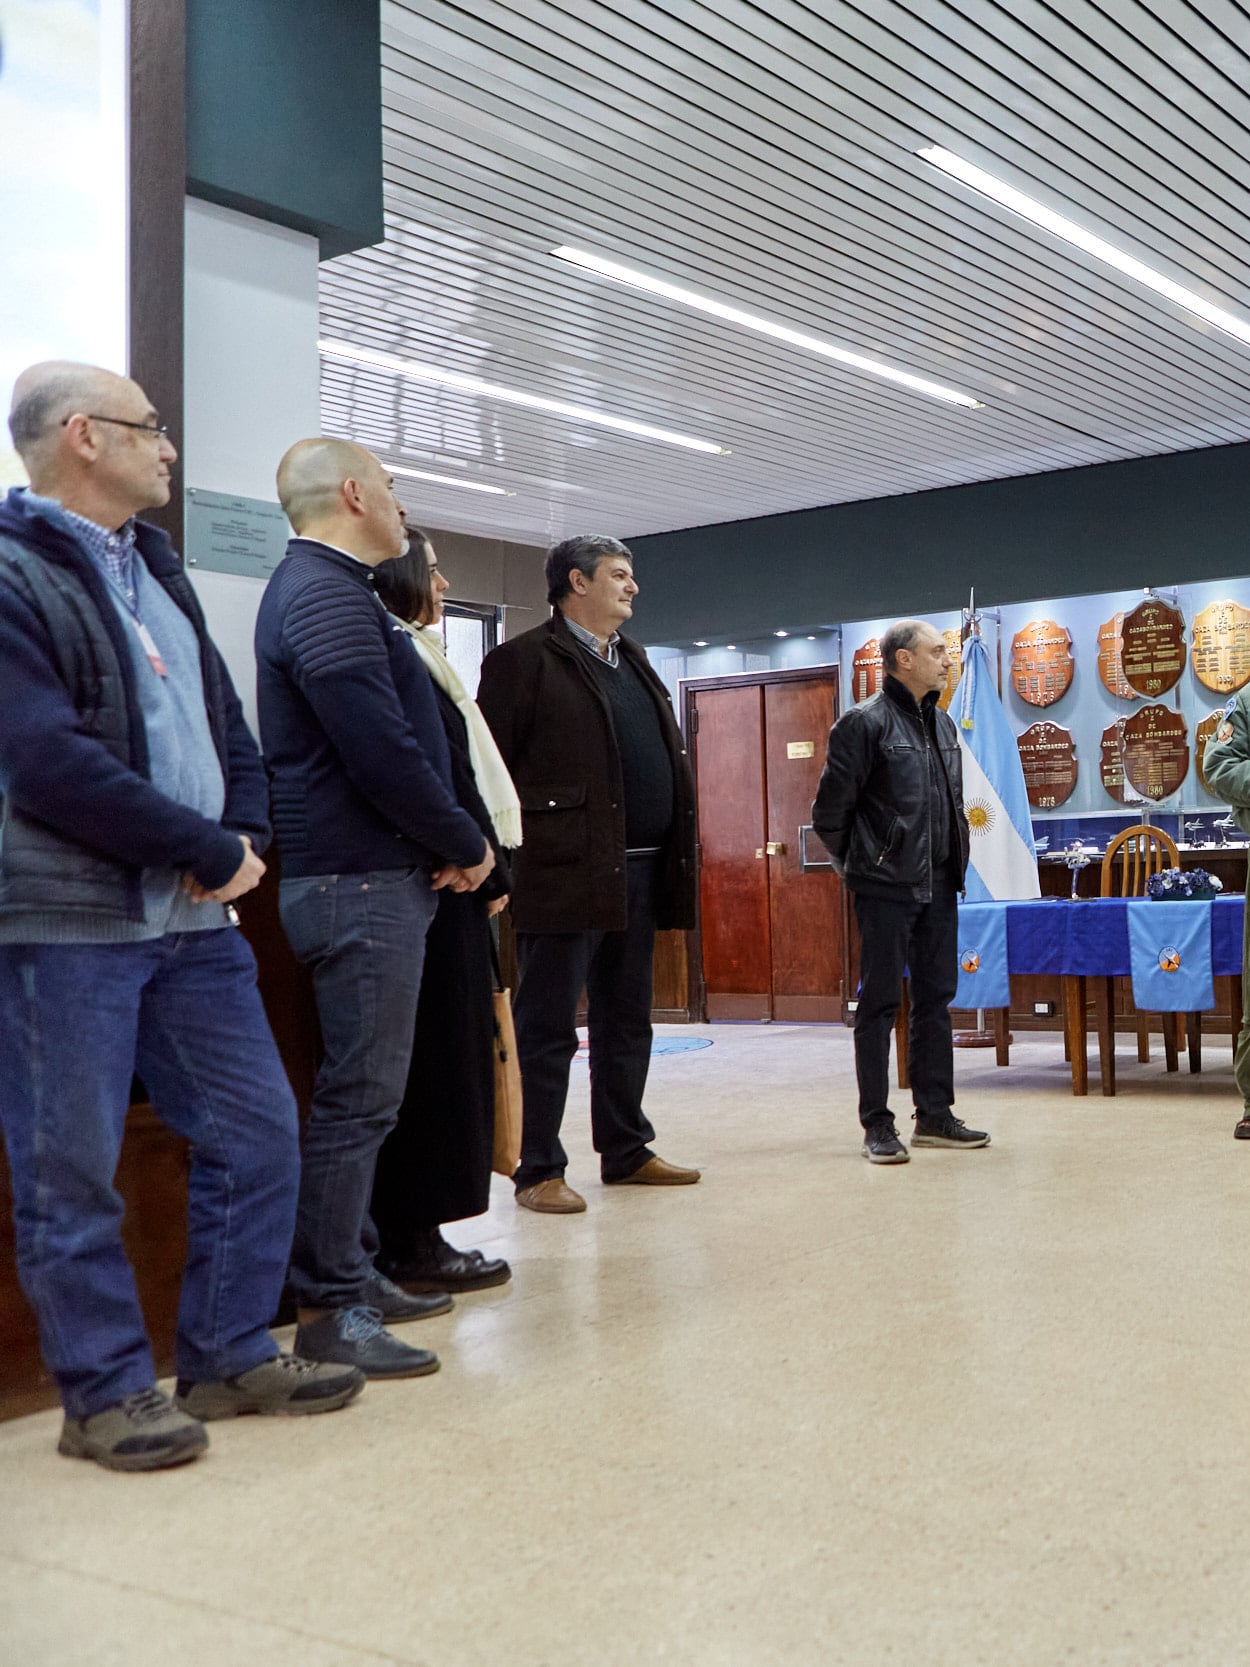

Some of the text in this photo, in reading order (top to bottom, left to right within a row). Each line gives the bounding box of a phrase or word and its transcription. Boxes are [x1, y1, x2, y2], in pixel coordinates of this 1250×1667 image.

[1140, 708, 1164, 719] GRUPO
[1030, 725, 1056, 736] GRUPO
[1125, 729, 1182, 741] CAZA BOMBARDEO
